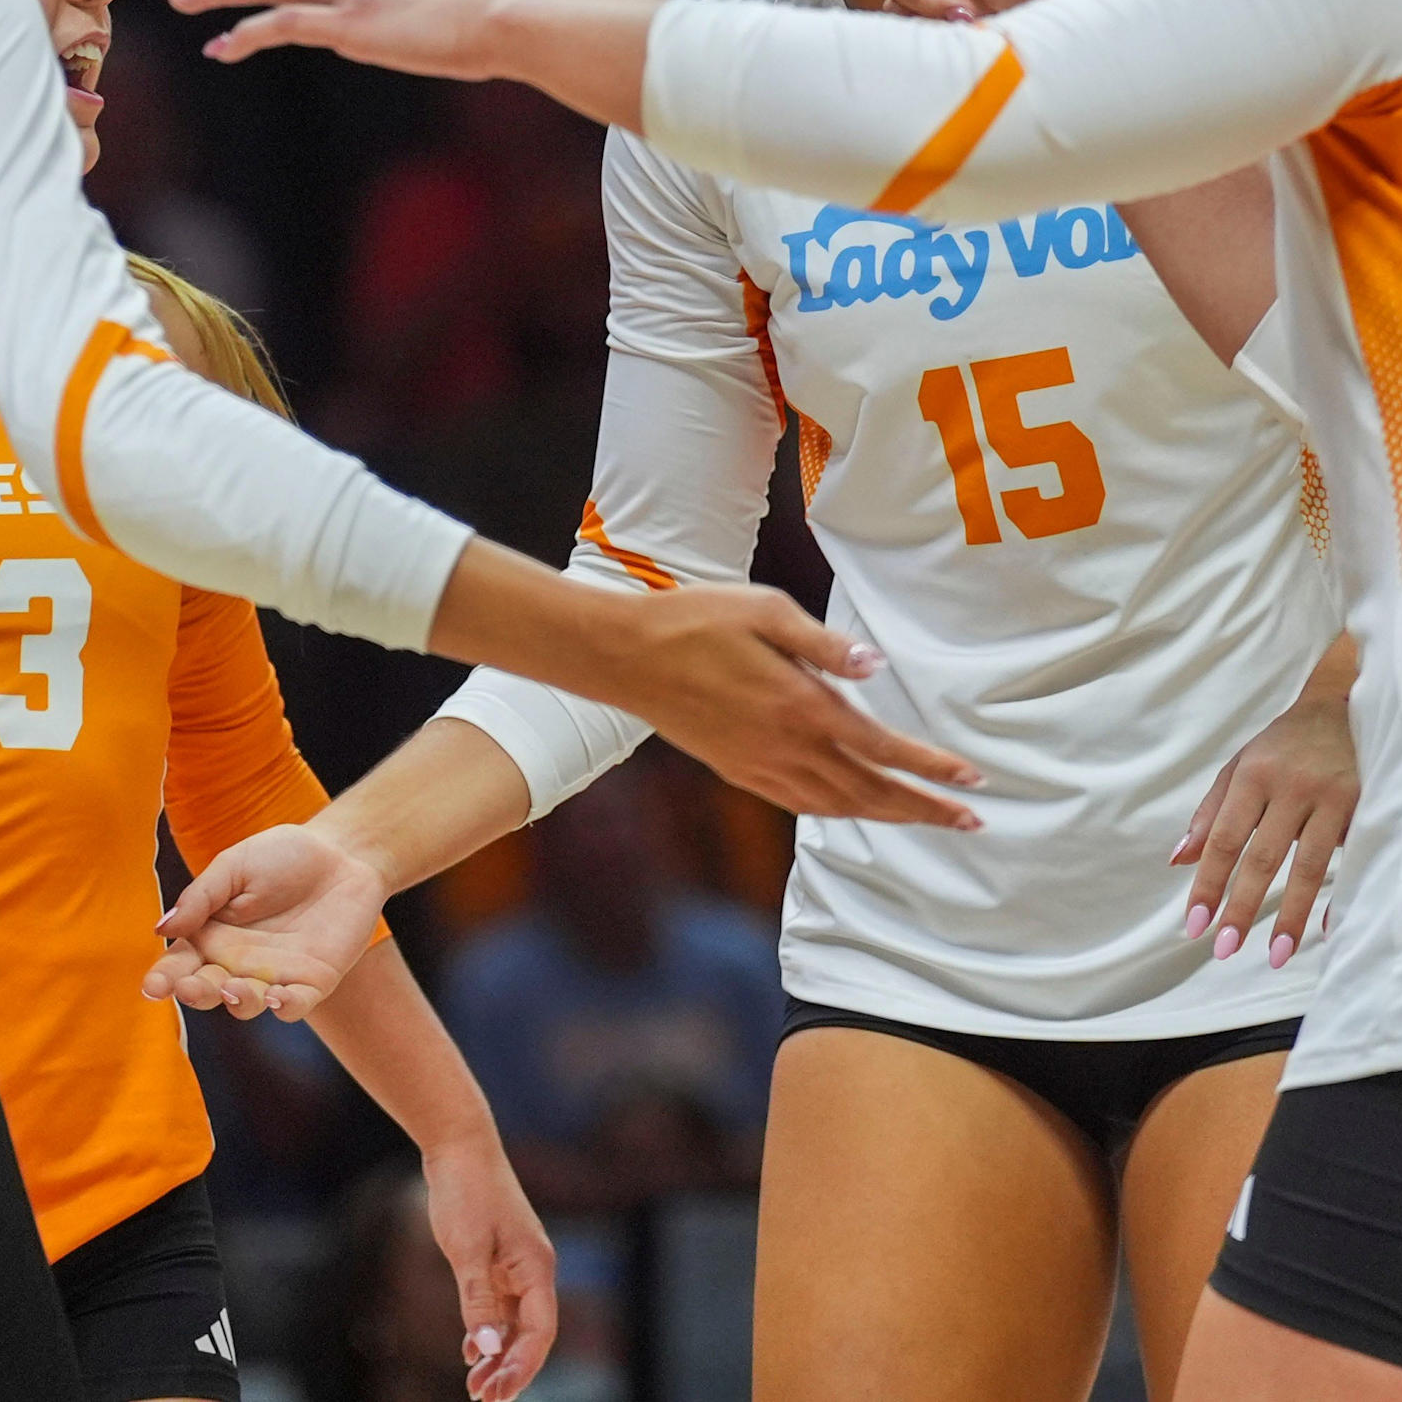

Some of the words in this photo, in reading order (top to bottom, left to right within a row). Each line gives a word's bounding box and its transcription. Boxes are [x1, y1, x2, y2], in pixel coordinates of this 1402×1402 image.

[781, 202, 989, 321] Lady
[998, 202, 1142, 279] Vol
[917, 346, 1106, 546] 15
